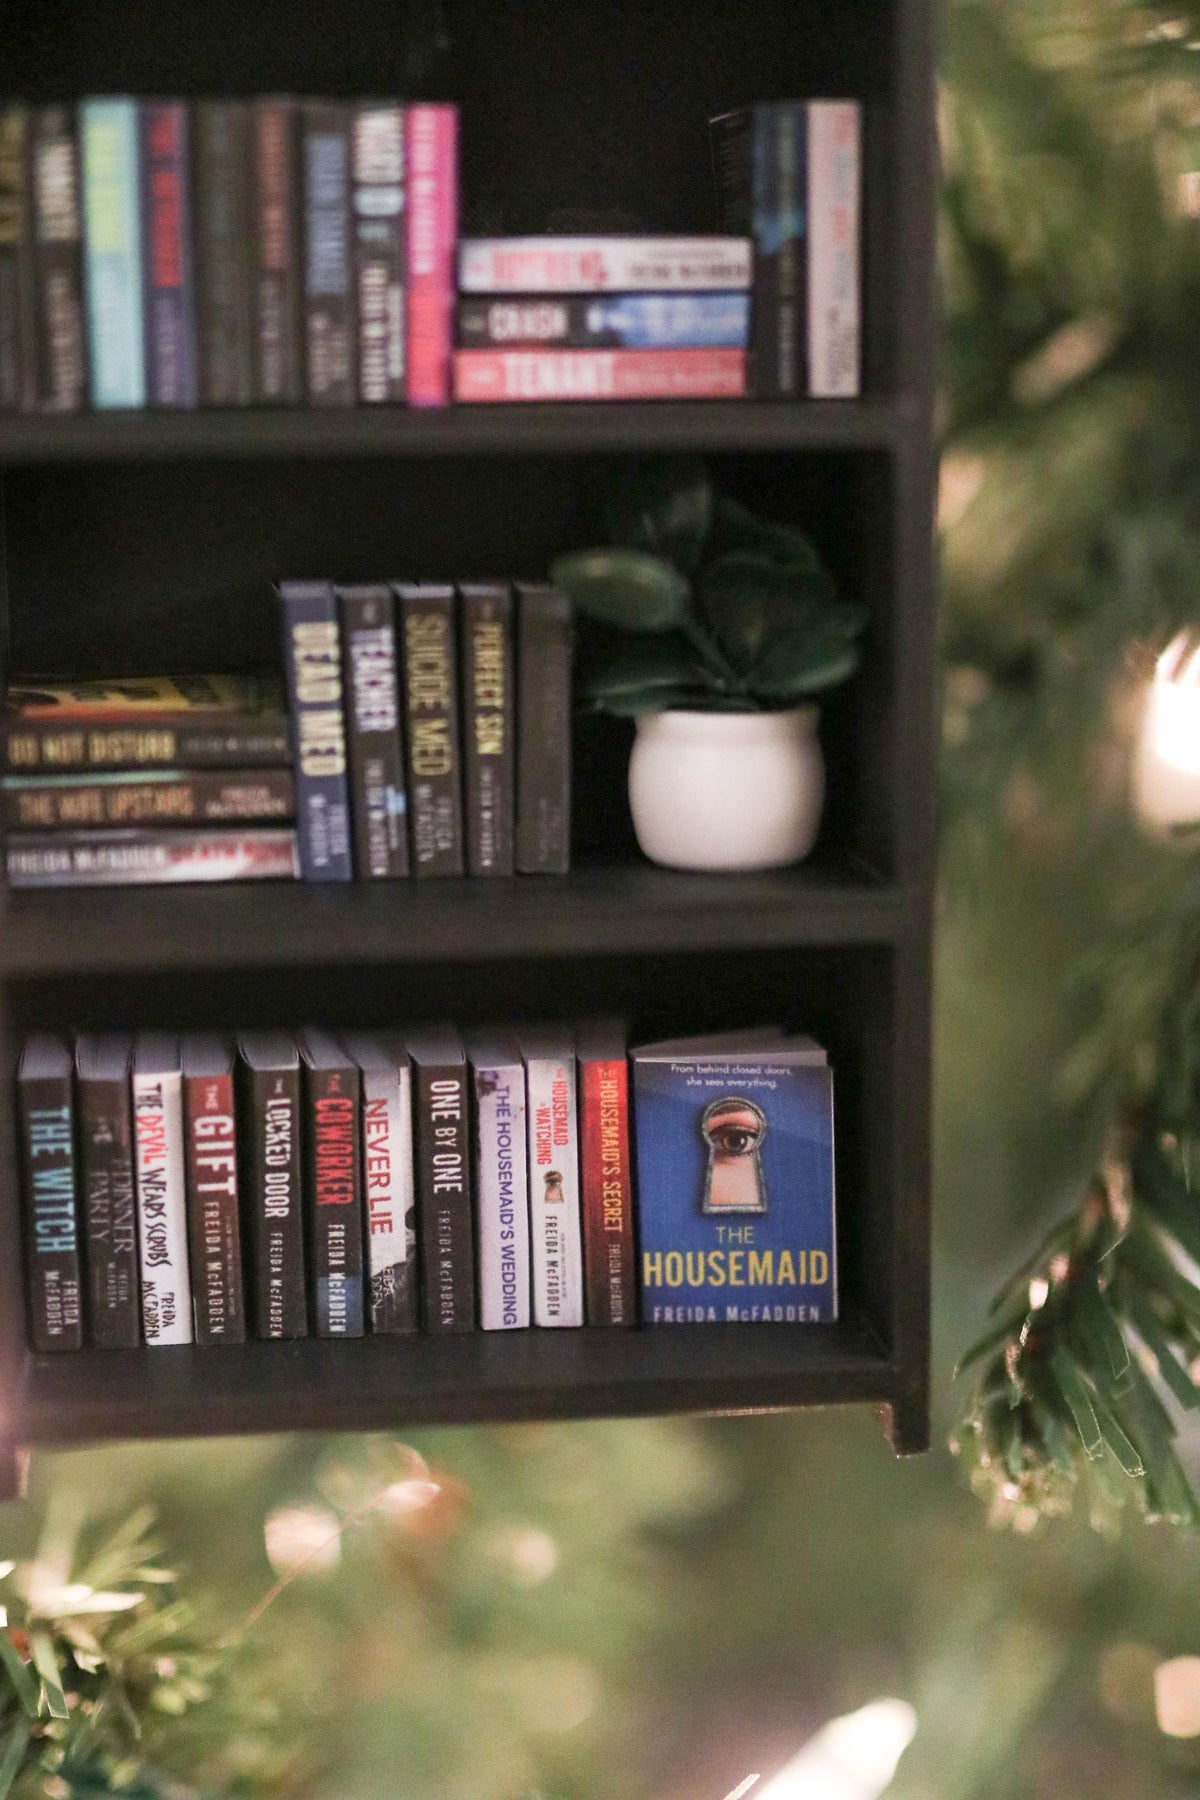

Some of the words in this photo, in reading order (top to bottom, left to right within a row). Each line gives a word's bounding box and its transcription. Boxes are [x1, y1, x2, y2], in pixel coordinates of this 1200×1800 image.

[293, 621, 342, 703] DEAD
[405, 614, 449, 710] SUICIDE
[474, 622, 503, 706] PERFECT
[89, 730, 175, 763] DISTURB
[300, 709, 346, 777] MED
[411, 718, 450, 775] MED
[475, 712, 503, 754] SON
[109, 787, 193, 820] UPSTAIRS
[671, 1064, 694, 1074] From
[696, 1064, 730, 1075] behind
[732, 1064, 761, 1075] closed
[686, 1077, 702, 1086] she
[705, 1079, 724, 1088] sees
[136, 1083, 163, 1110] THE
[205, 1085, 218, 1110] THE
[431, 1080, 460, 1121] ONE
[496, 1085, 511, 1118] THE
[552, 1080, 568, 1146] HOUSEMAID
[29, 1106, 72, 1157] THE
[265, 1098, 291, 1166] LOCKED
[316, 1097, 353, 1206] COWORKER
[366, 1099, 390, 1188] NEVER
[435, 1127, 457, 1147] BY
[536, 1107, 552, 1165] WATCHING
[600, 1080, 620, 1177] HOUSEMAID'S
[194, 1115, 235, 1195] GIFT
[432, 1153, 462, 1194] ONE
[89, 1171, 110, 1241] PARTY
[140, 1168, 167, 1219] WEARS
[265, 1173, 289, 1218] DOOR
[497, 1122, 515, 1240] HOUSEMAID'S
[33, 1168, 76, 1252] WITCH
[113, 1168, 134, 1253] DINNER
[204, 1202, 221, 1254] FREIDA
[369, 1196, 393, 1235] LIE
[437, 1210, 450, 1254] FREIDA
[602, 1182, 623, 1233] SECRET
[145, 1222, 172, 1268] SCRUBS
[270, 1233, 283, 1272] FREIDA
[328, 1224, 345, 1265] FREIDA
[545, 1215, 558, 1255] FREIDA
[608, 1244, 620, 1274] FREIDA
[716, 1226, 755, 1244] THE
[439, 1261, 454, 1325] McFADDEN
[500, 1244, 517, 1326] WEDDING
[546, 1260, 560, 1317] McFADDEN
[643, 1250, 829, 1287] HOUSEMAID
[45, 1271, 62, 1335] McFADDEN
[63, 1281, 78, 1325] FREIDA
[206, 1262, 224, 1334] McFADDEN
[270, 1279, 283, 1338] McFADDEN
[329, 1273, 346, 1332] McFADDEN
[653, 1306, 717, 1322] FREIDA
[726, 1305, 820, 1322] McFADDEN
